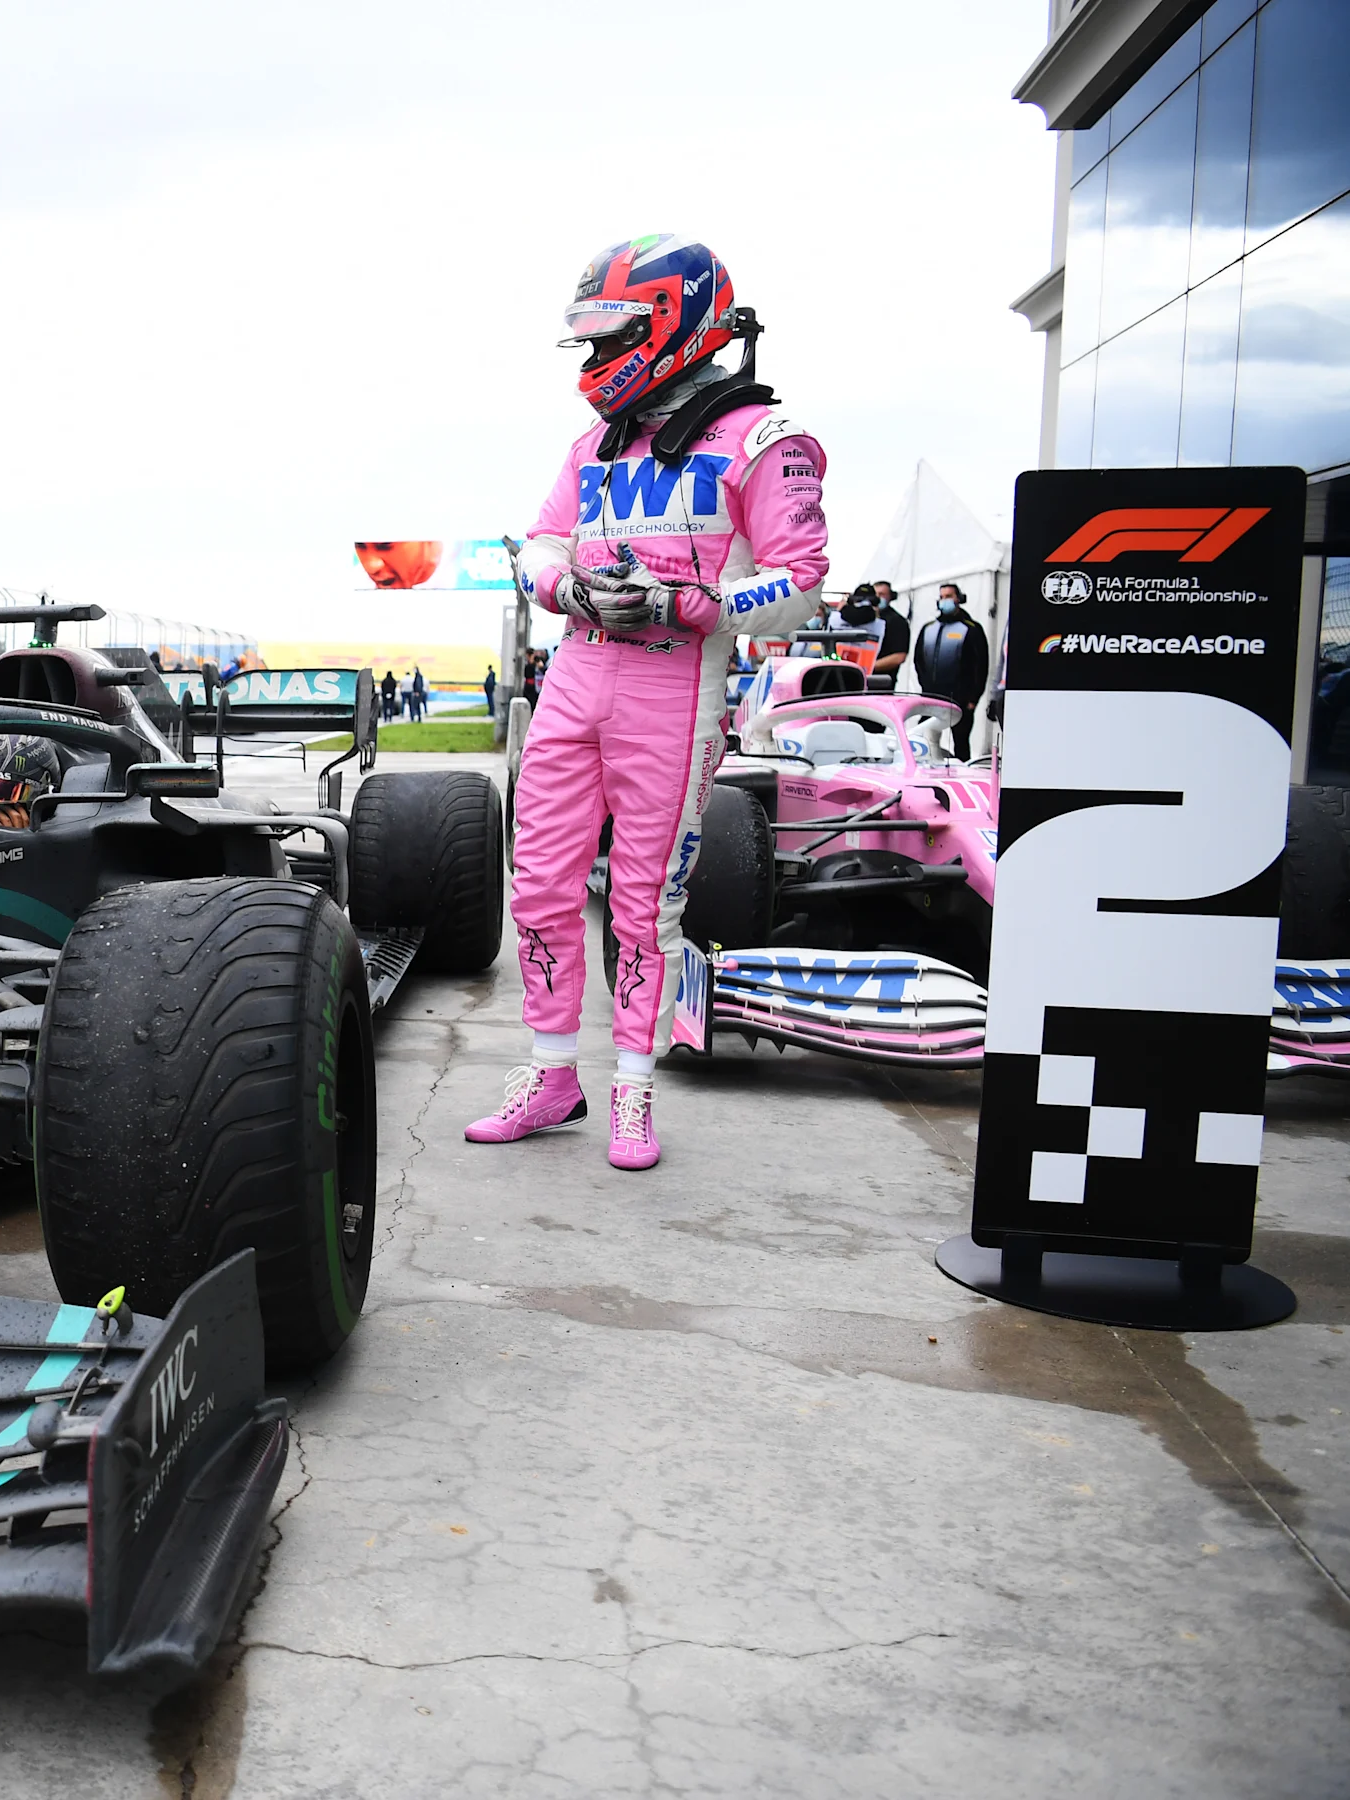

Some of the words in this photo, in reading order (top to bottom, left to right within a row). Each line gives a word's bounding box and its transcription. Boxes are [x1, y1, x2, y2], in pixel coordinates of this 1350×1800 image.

[601, 302, 626, 311] BWT
[611, 352, 646, 390] BWT
[655, 358, 674, 377] BELL
[579, 453, 733, 524] BWT
[733, 578, 791, 614] BWT
[1096, 577, 1122, 589] FIA
[1125, 576, 1190, 589] Formula
[1190, 577, 1200, 589] 1
[1096, 590, 1145, 602] World
[1145, 590, 1256, 604] Championship
[1062, 633, 1266, 654] #WeRaceAsOne
[40, 711, 69, 723] END
[72, 715, 112, 733] RACISM
[695, 740, 713, 815] MAGNESIUM
[784, 785, 814, 798] RAVENOL
[985, 690, 1292, 1054] 2
[716, 954, 918, 1013] BWT
[149, 1324, 199, 1459] IWC
[134, 1392, 216, 1534] SCHAFFHAUSEN
